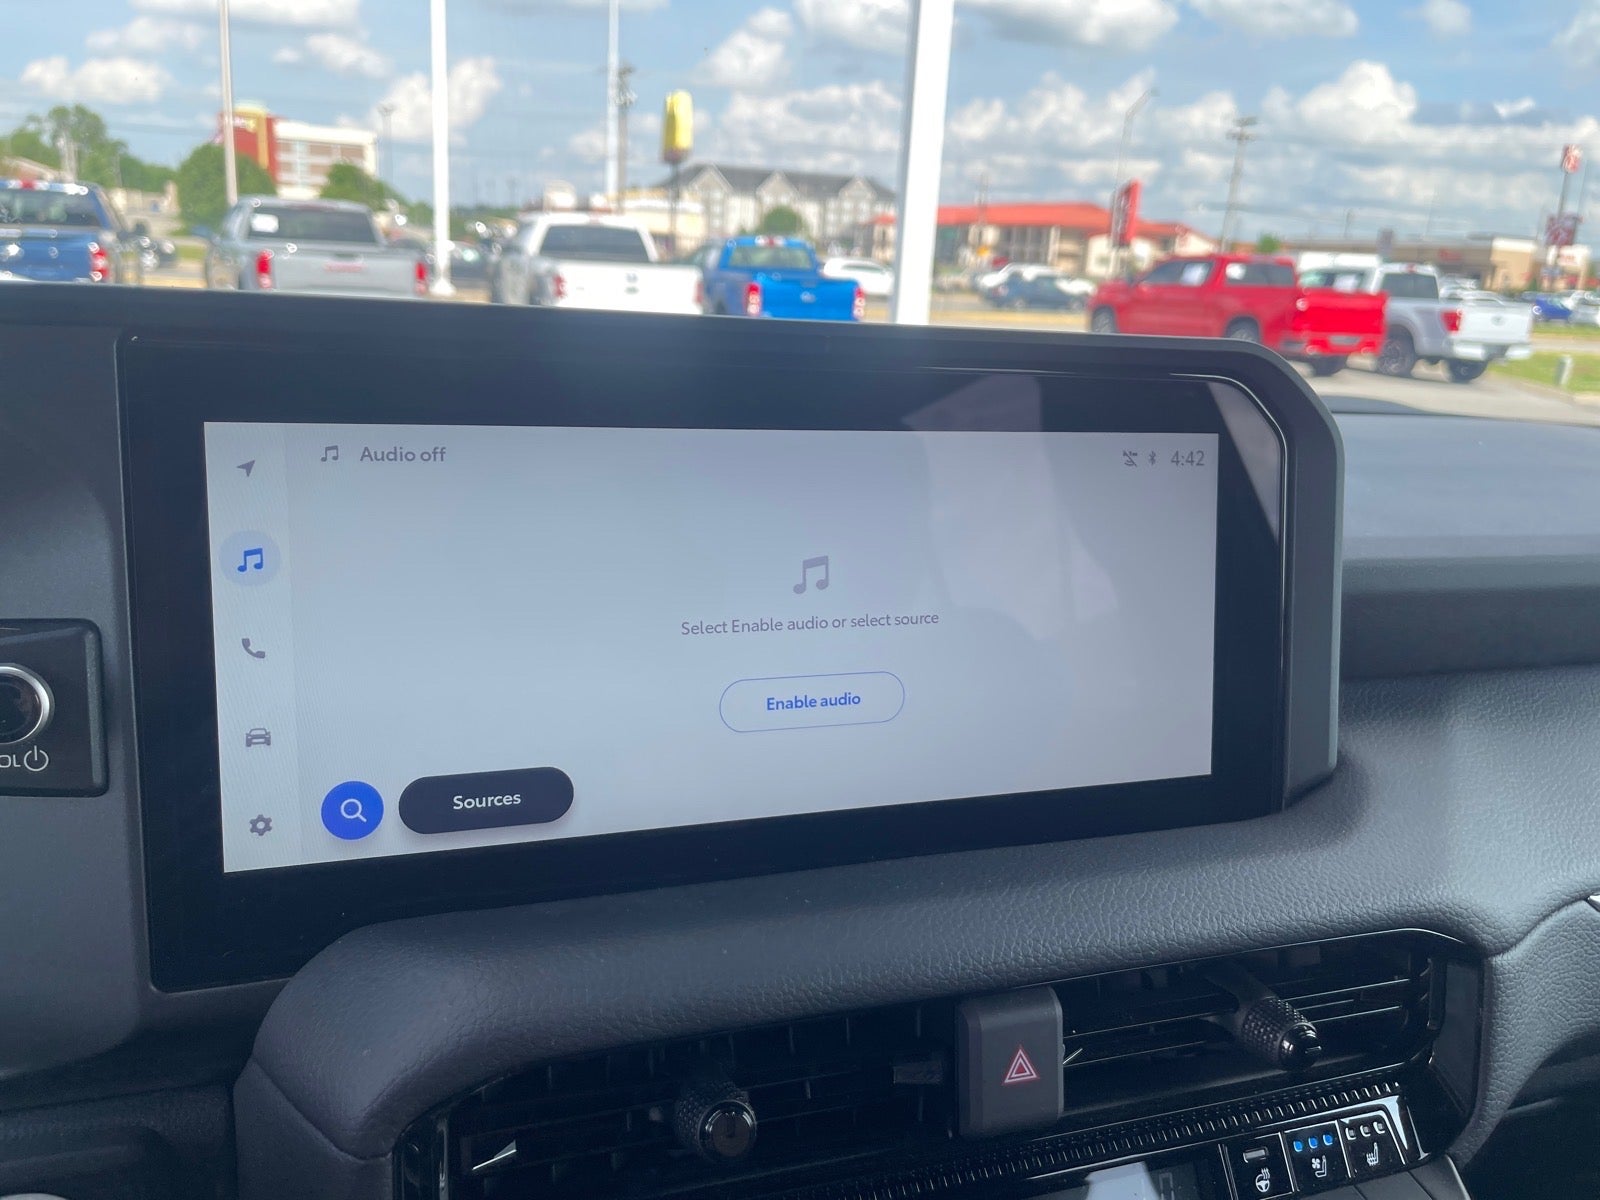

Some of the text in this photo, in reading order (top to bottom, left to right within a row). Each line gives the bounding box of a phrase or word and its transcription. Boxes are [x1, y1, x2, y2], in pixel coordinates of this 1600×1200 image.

[359, 446, 447, 463] Audio off
[1170, 450, 1206, 467] 4:42
[681, 611, 940, 636] Select Enable audio or select source
[766, 691, 862, 711] Enable audio
[452, 791, 522, 812] Sources
